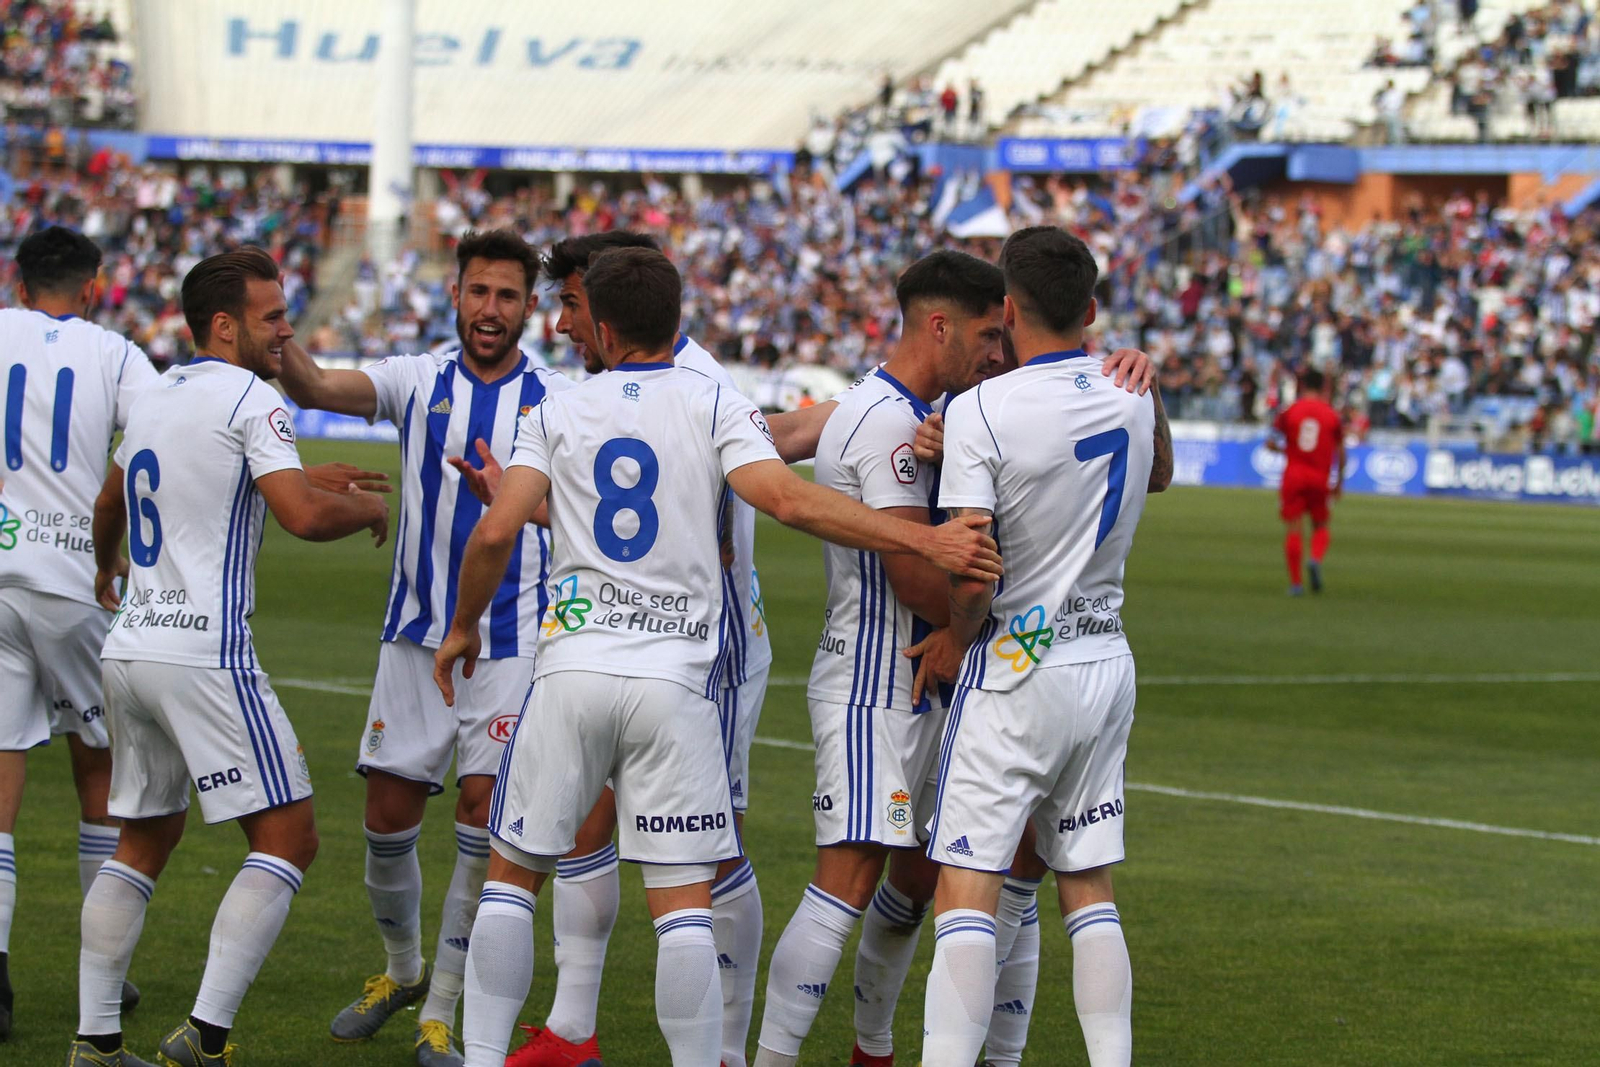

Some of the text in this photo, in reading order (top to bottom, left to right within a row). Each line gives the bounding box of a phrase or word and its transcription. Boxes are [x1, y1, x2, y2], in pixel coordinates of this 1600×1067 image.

[226, 17, 642, 69] Huelva
[5, 364, 75, 473] 11
[593, 437, 659, 562] 8
[1073, 427, 1130, 551] 7
[25, 509, 91, 531] Que se
[127, 448, 163, 567] 6
[26, 526, 50, 544] de
[129, 587, 186, 608] Que sea
[599, 582, 689, 612] Que sea
[593, 609, 623, 628] de
[635, 812, 727, 833] ROMERO
